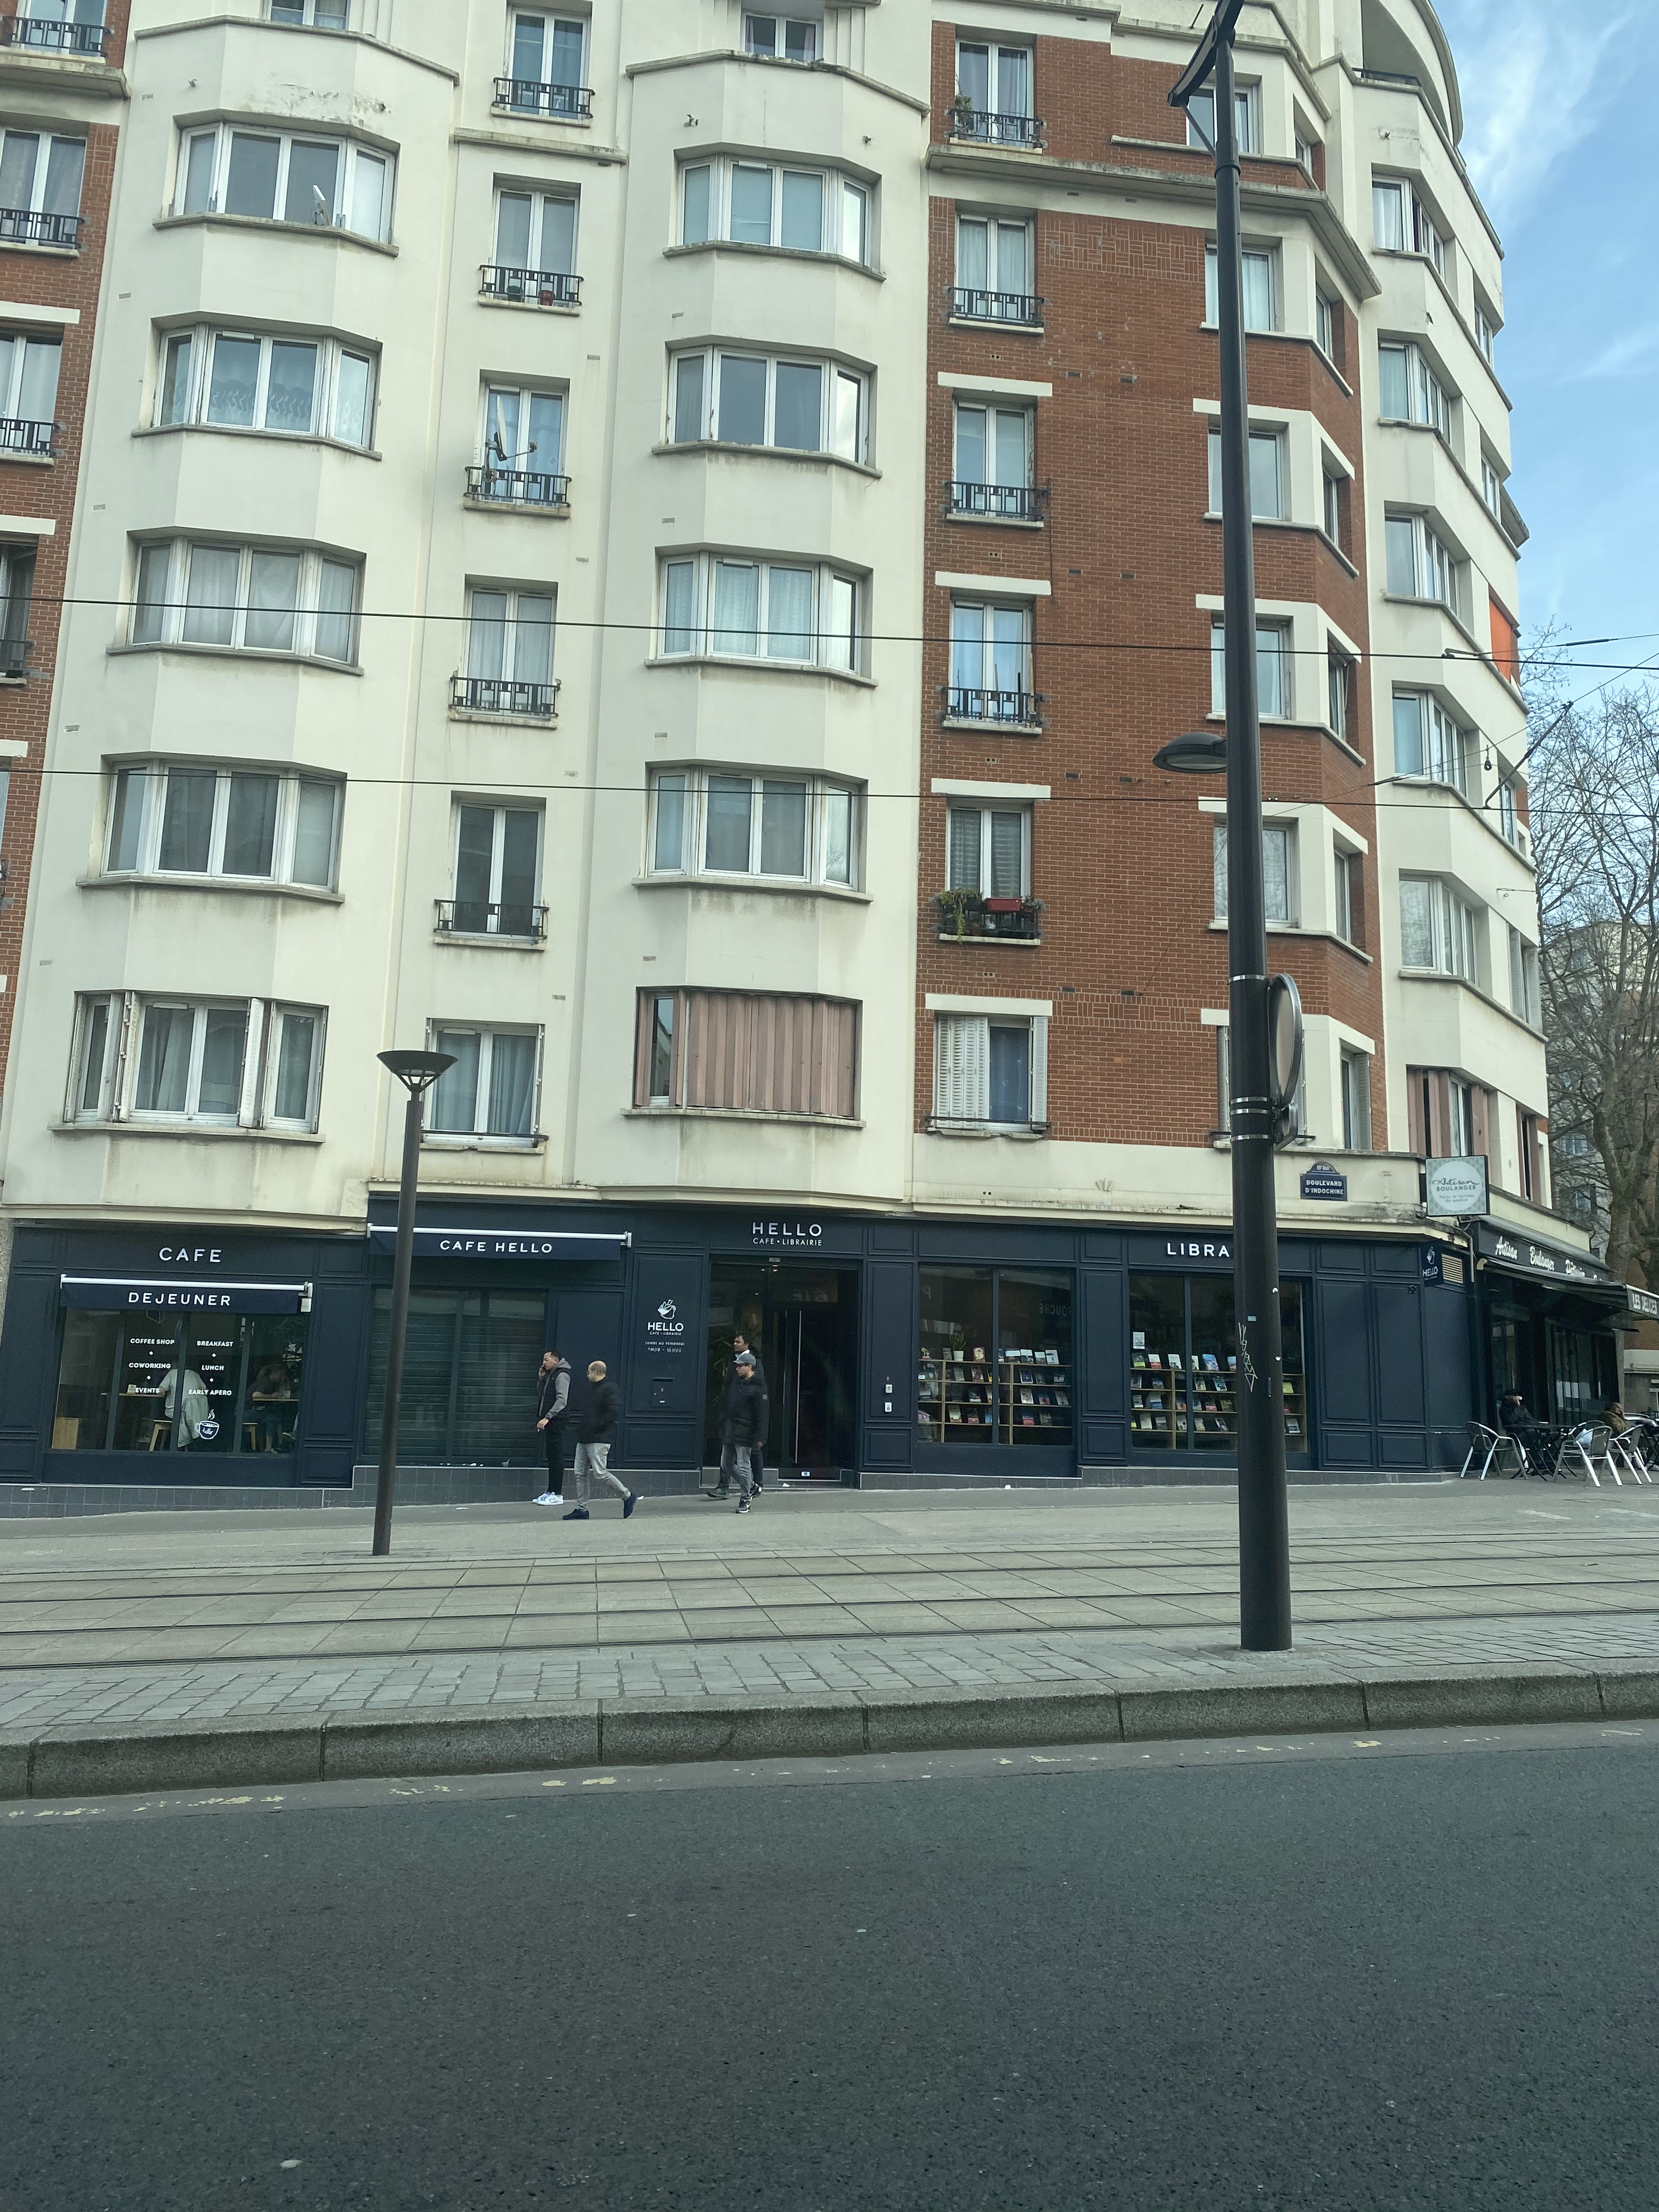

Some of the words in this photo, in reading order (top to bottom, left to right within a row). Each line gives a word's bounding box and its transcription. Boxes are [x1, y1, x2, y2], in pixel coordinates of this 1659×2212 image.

[752, 1222, 822, 1237] HELLO
[440, 1240, 486, 1251] CAFE
[495, 1242, 552, 1253] HELLO
[1167, 1243, 1230, 1257] LIBRA
[159, 1247, 222, 1262] CAFE
[1423, 1266, 1437, 1277] HELLO
[128, 1292, 230, 1306] DEJEUNER
[1632, 1293, 1641, 1310] LES
[647, 1322, 684, 1331] HELLO
